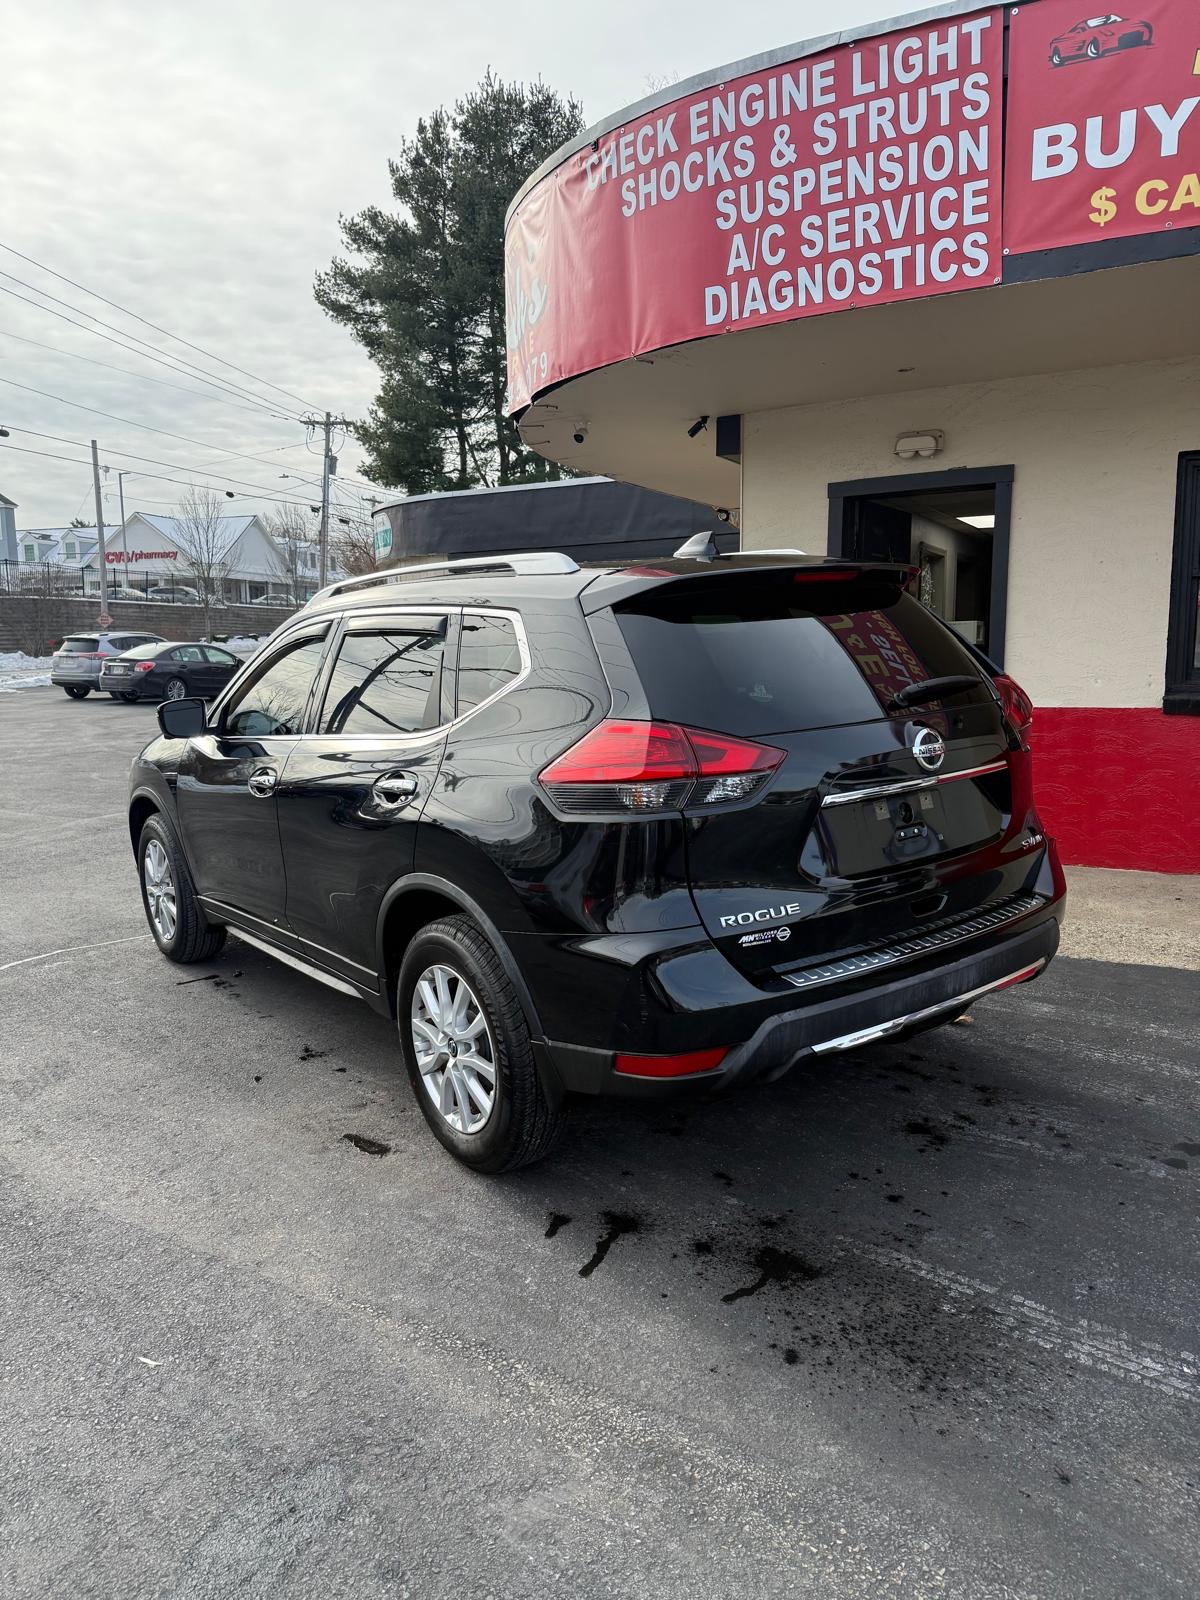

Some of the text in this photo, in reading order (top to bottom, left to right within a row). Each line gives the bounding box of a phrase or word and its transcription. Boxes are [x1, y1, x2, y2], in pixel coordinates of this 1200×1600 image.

[585, 16, 992, 191] CHECK ENGINE LIGHT
[621, 72, 991, 217] SHOCKS & STRUTS
[1031, 96, 1200, 181] BUY
[715, 125, 989, 230] SUSPENSION
[1088, 186, 1118, 227] $
[726, 179, 989, 276] A/C SERVICE
[704, 232, 989, 325] DIAGNOSTICS
[720, 903, 800, 928] ROGUE
